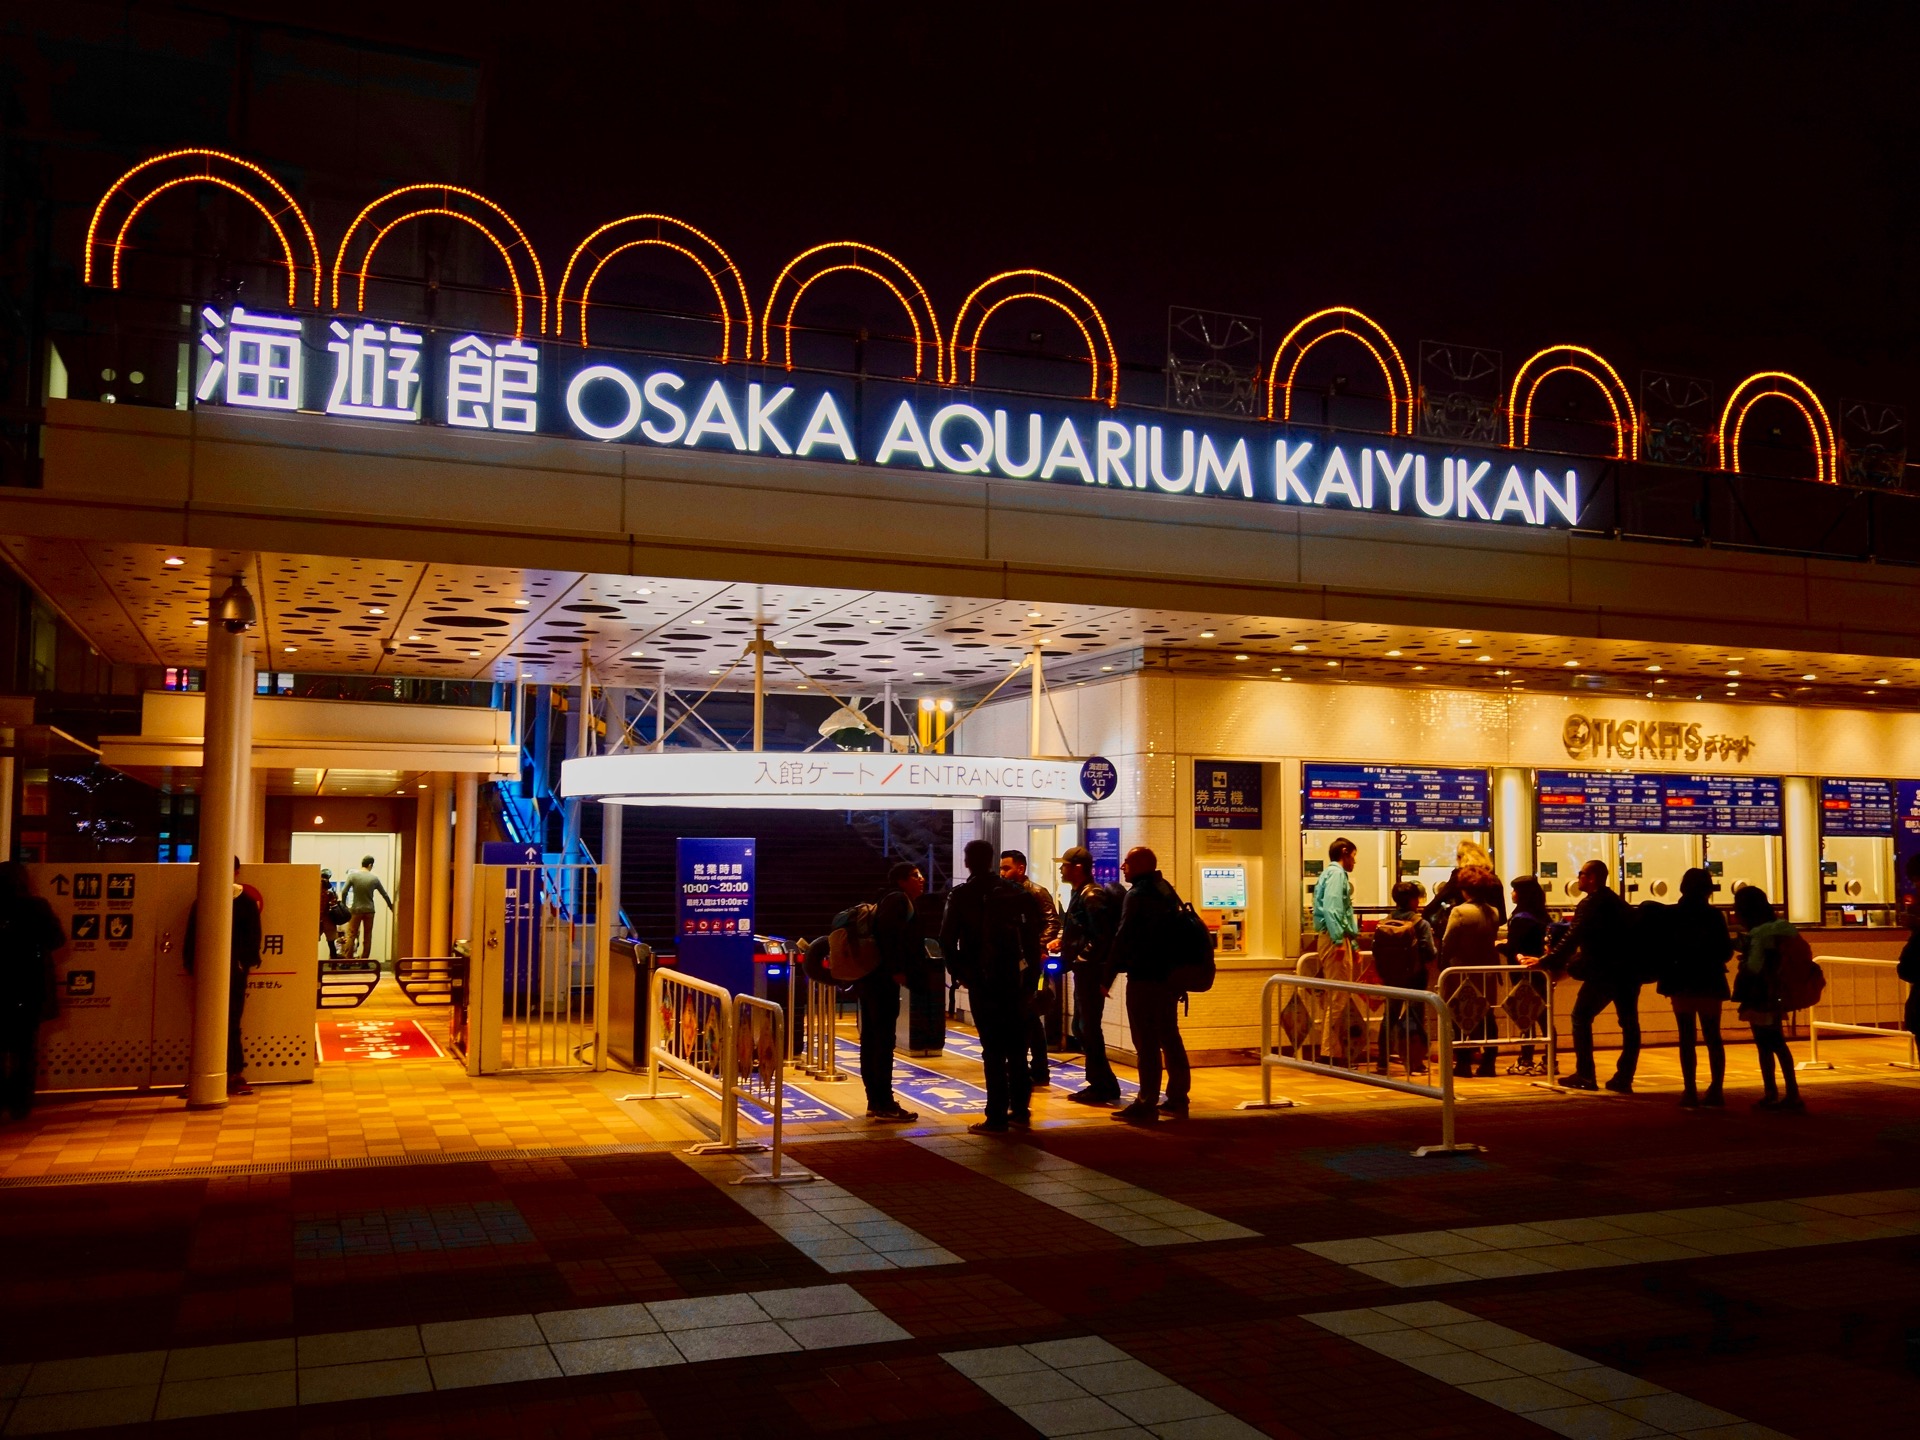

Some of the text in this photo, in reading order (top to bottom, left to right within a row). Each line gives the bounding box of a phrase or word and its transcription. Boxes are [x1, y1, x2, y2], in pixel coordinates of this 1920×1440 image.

[196, 306, 1579, 526] 海遊館 OSAKA AQUARIUM KAIYUKAN
[1594, 718, 1703, 753] TICKETS
[754, 760, 875, 786] 入館ゲート
[909, 764, 1025, 789] ENTRANCE
[1031, 768, 1067, 791] GATE
[1083, 771, 1114, 779] パスポート
[1092, 779, 1106, 787] 入口
[1196, 790, 1244, 806] 券売機
[1202, 805, 1229, 814] Vending
[366, 812, 378, 828] 2
[1400, 833, 1408, 846] 2
[1536, 835, 1543, 848] 3
[693, 864, 743, 875] 営業時間
[262, 935, 284, 955] 用
